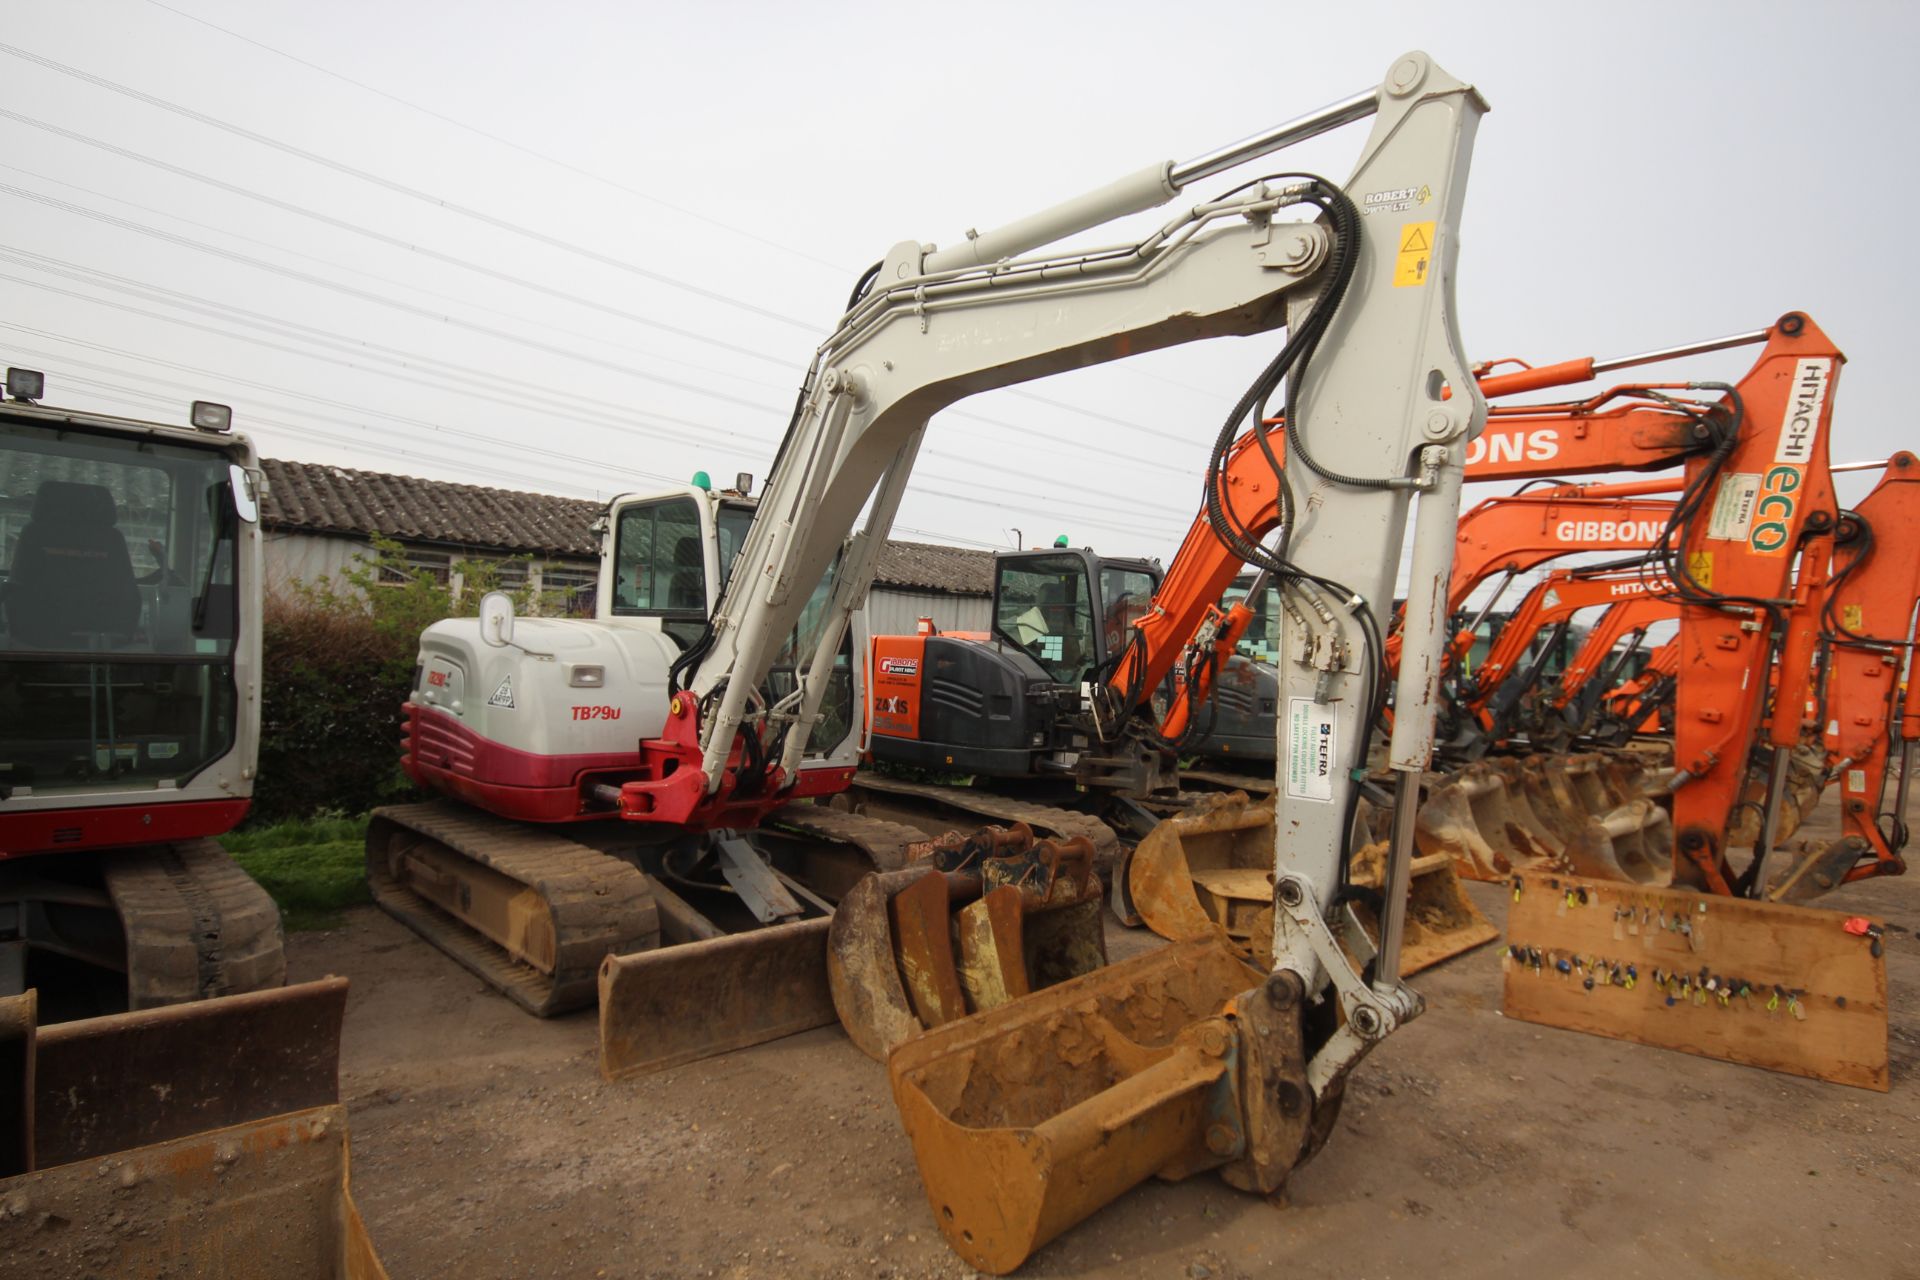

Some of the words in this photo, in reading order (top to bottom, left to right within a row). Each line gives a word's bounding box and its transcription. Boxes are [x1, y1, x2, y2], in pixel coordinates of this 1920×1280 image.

[1364, 187, 1418, 205] ROBERT
[1784, 365, 1822, 457] HITACHI
[1556, 520, 1677, 543] GIBBONS
[1610, 579, 1677, 596] HITACH
[875, 695, 909, 714] ZAXIS
[1318, 737, 1329, 777] TEFRA
